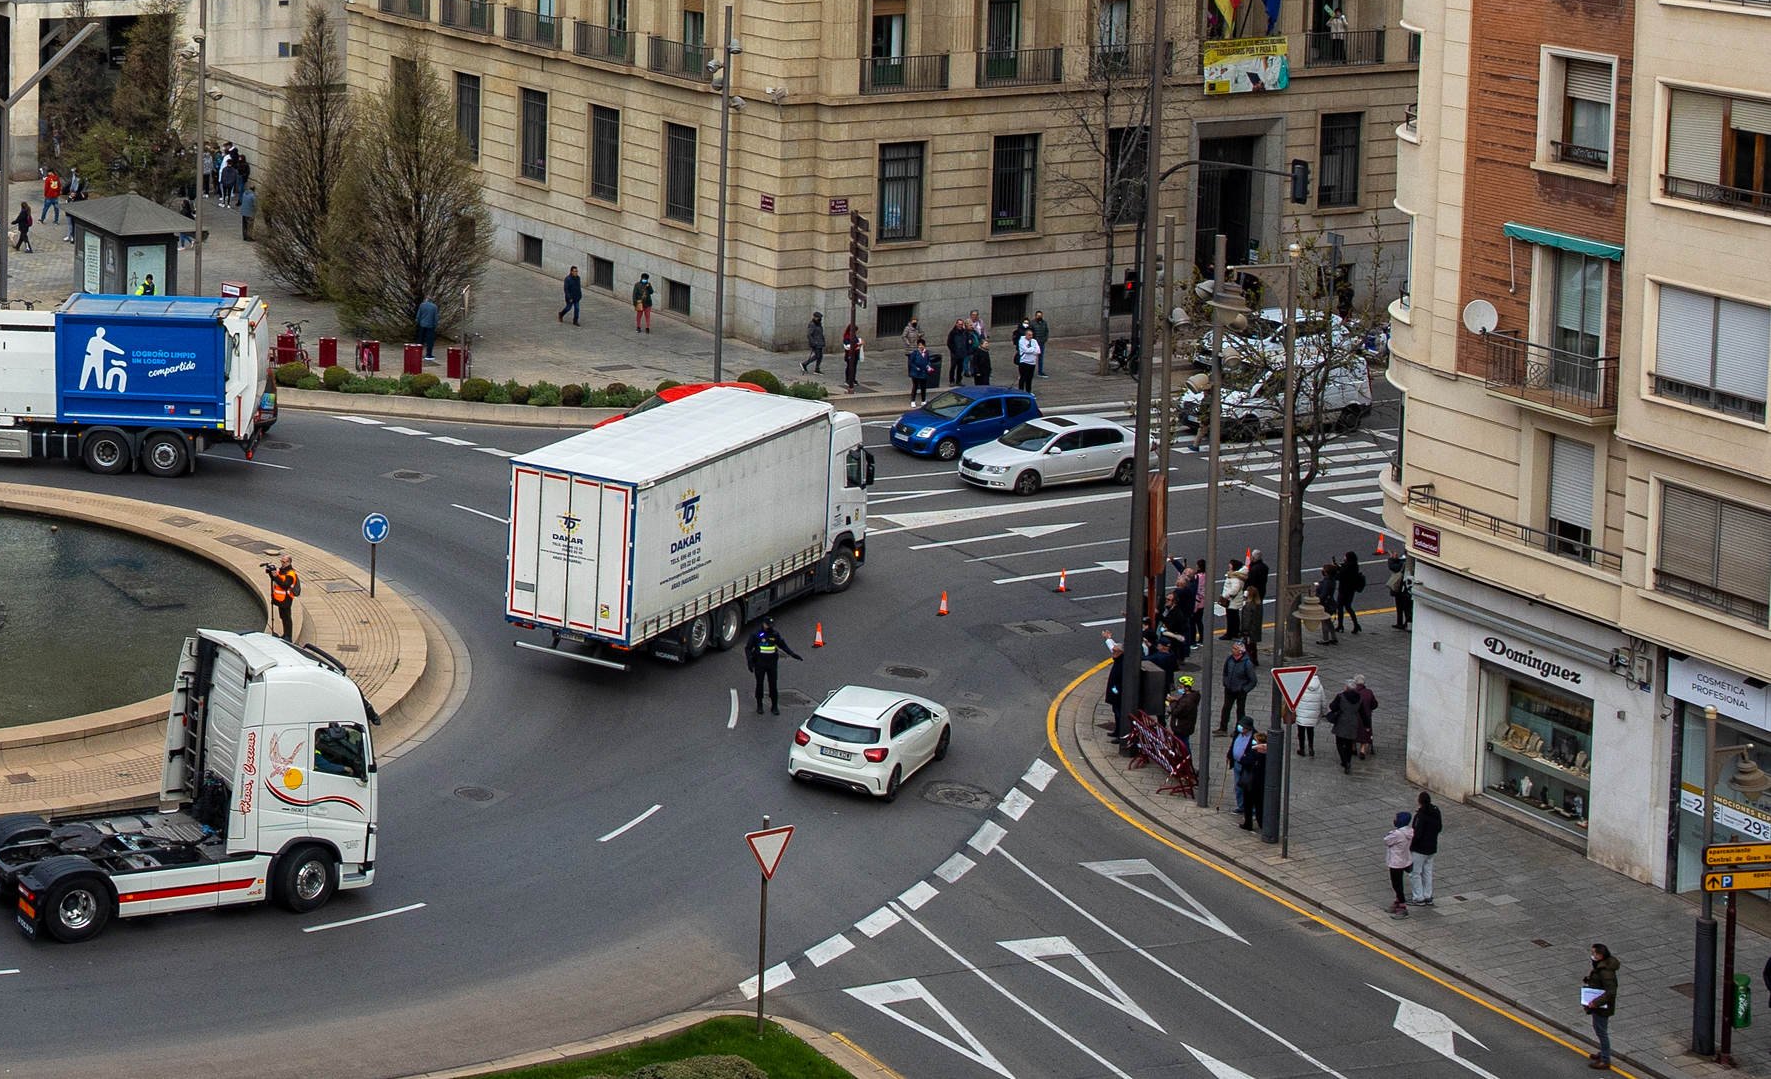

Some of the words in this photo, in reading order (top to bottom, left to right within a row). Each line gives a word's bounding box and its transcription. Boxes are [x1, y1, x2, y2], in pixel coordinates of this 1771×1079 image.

[131, 350, 169, 358] LOGROÑO
[171, 351, 196, 359] LIMPIO
[148, 361, 196, 378] compartido
[670, 532, 701, 554] DAKAR
[1691, 683, 1750, 710] PROFESIONAL
[244, 731, 257, 776] Cuevas
[238, 779, 255, 815] Hnos.
[1702, 790, 1755, 816] MOCIONES
[1744, 817, 1761, 835] 29
[1709, 847, 1751, 855] aparcamiento
[1722, 876, 1732, 888] P
